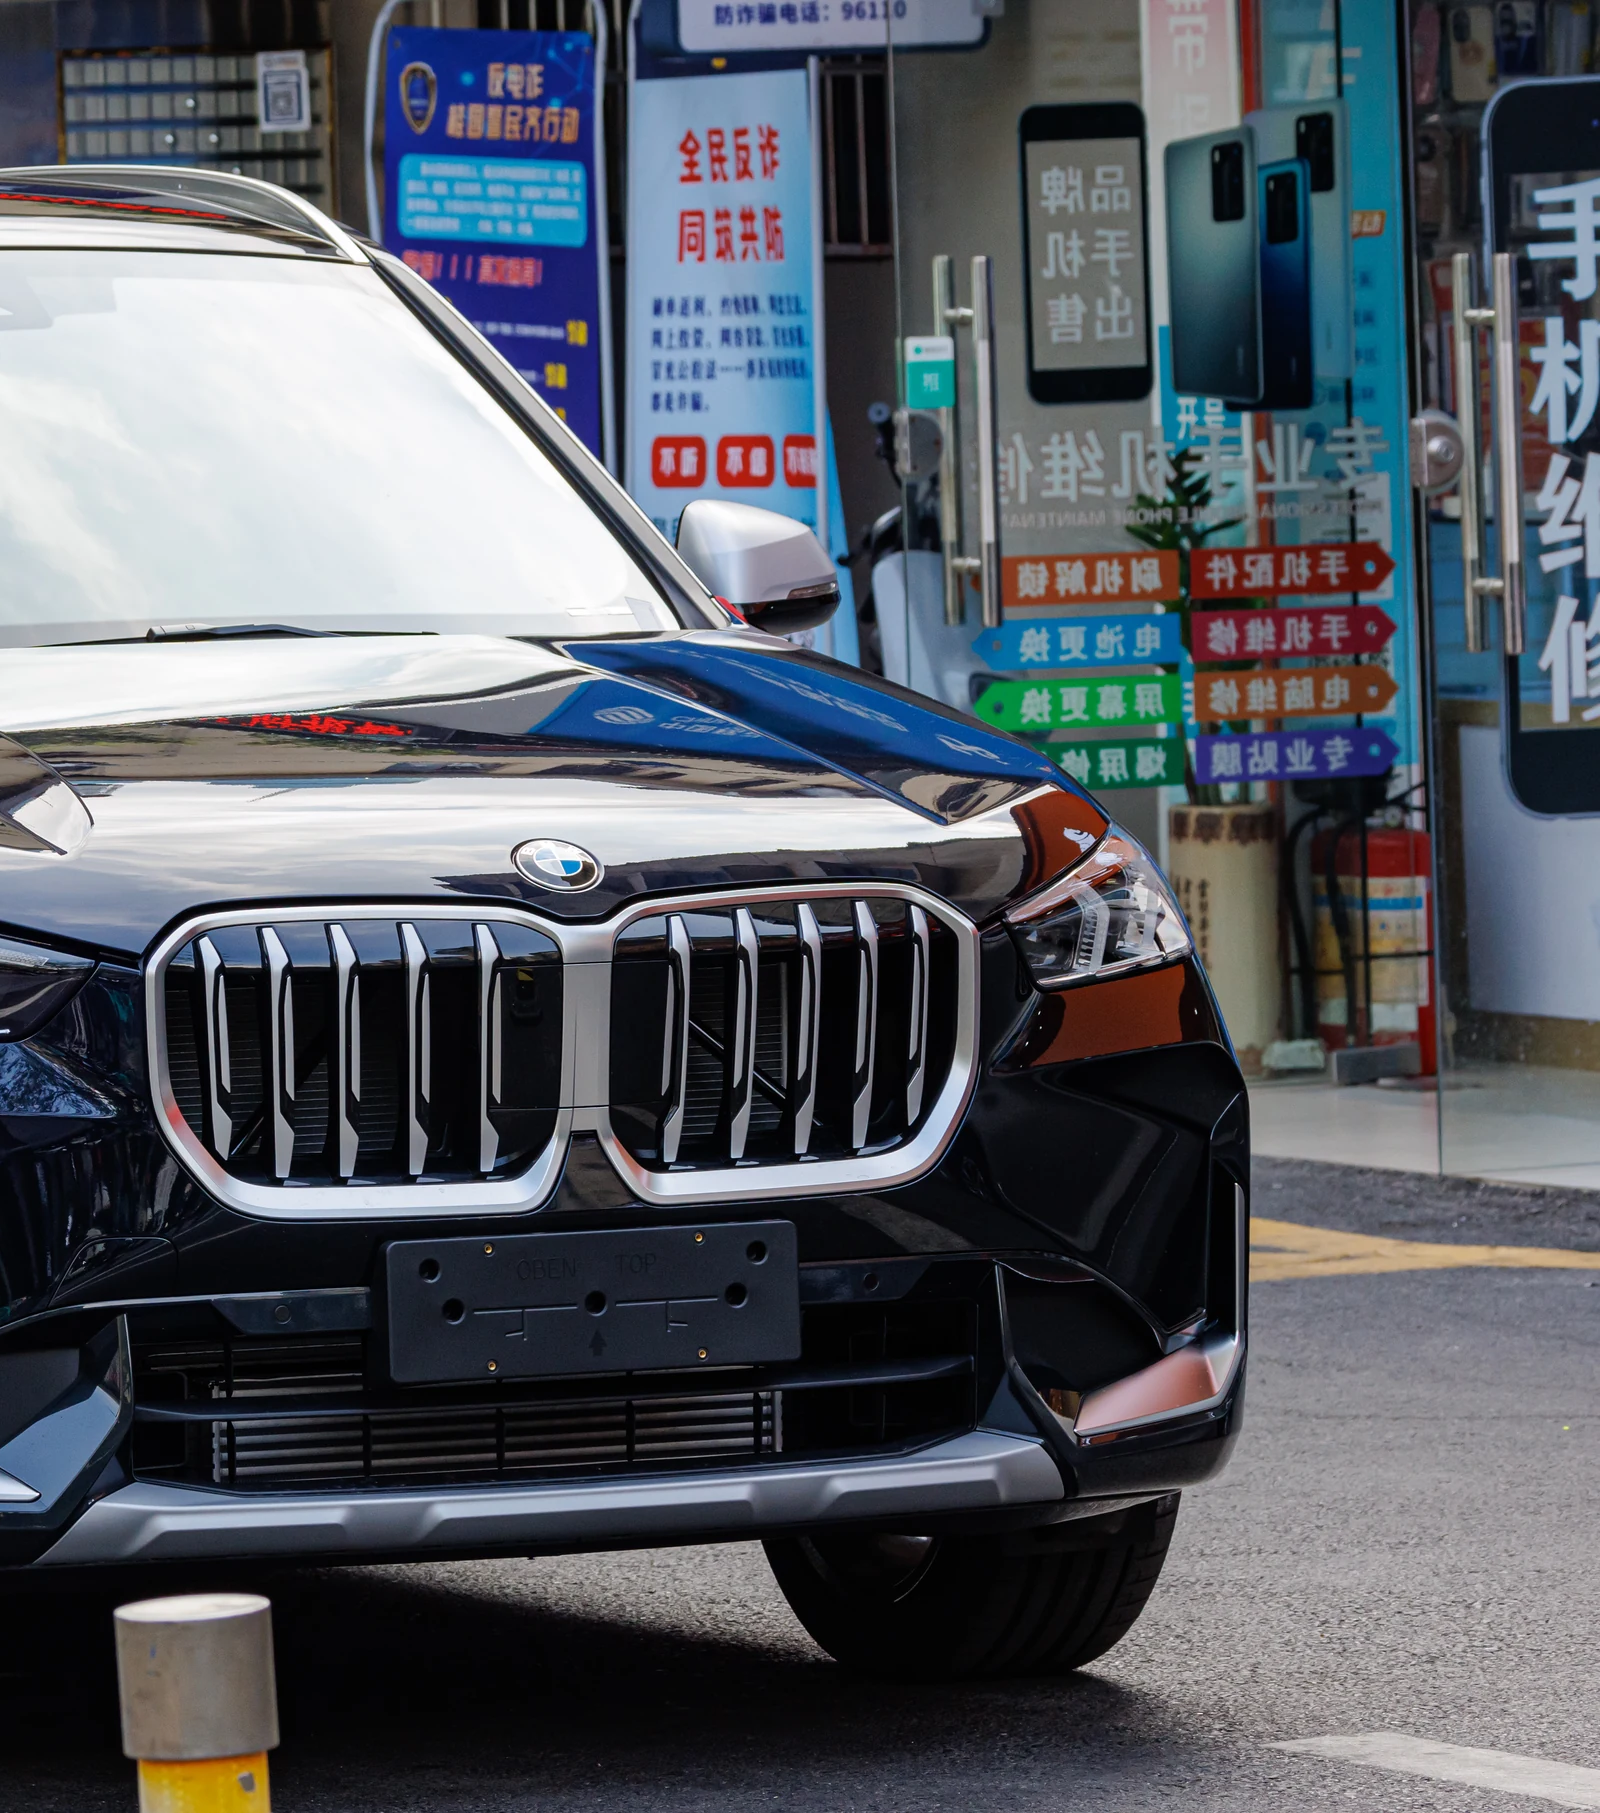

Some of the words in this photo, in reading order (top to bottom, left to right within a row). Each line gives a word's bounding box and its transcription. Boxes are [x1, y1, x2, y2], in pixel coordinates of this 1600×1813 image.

[678, 124, 780, 184] 全民反诈
[677, 204, 785, 264] 同筑共防
[517, 1257, 577, 1281] OBEN
[614, 1252, 658, 1275] TOP
